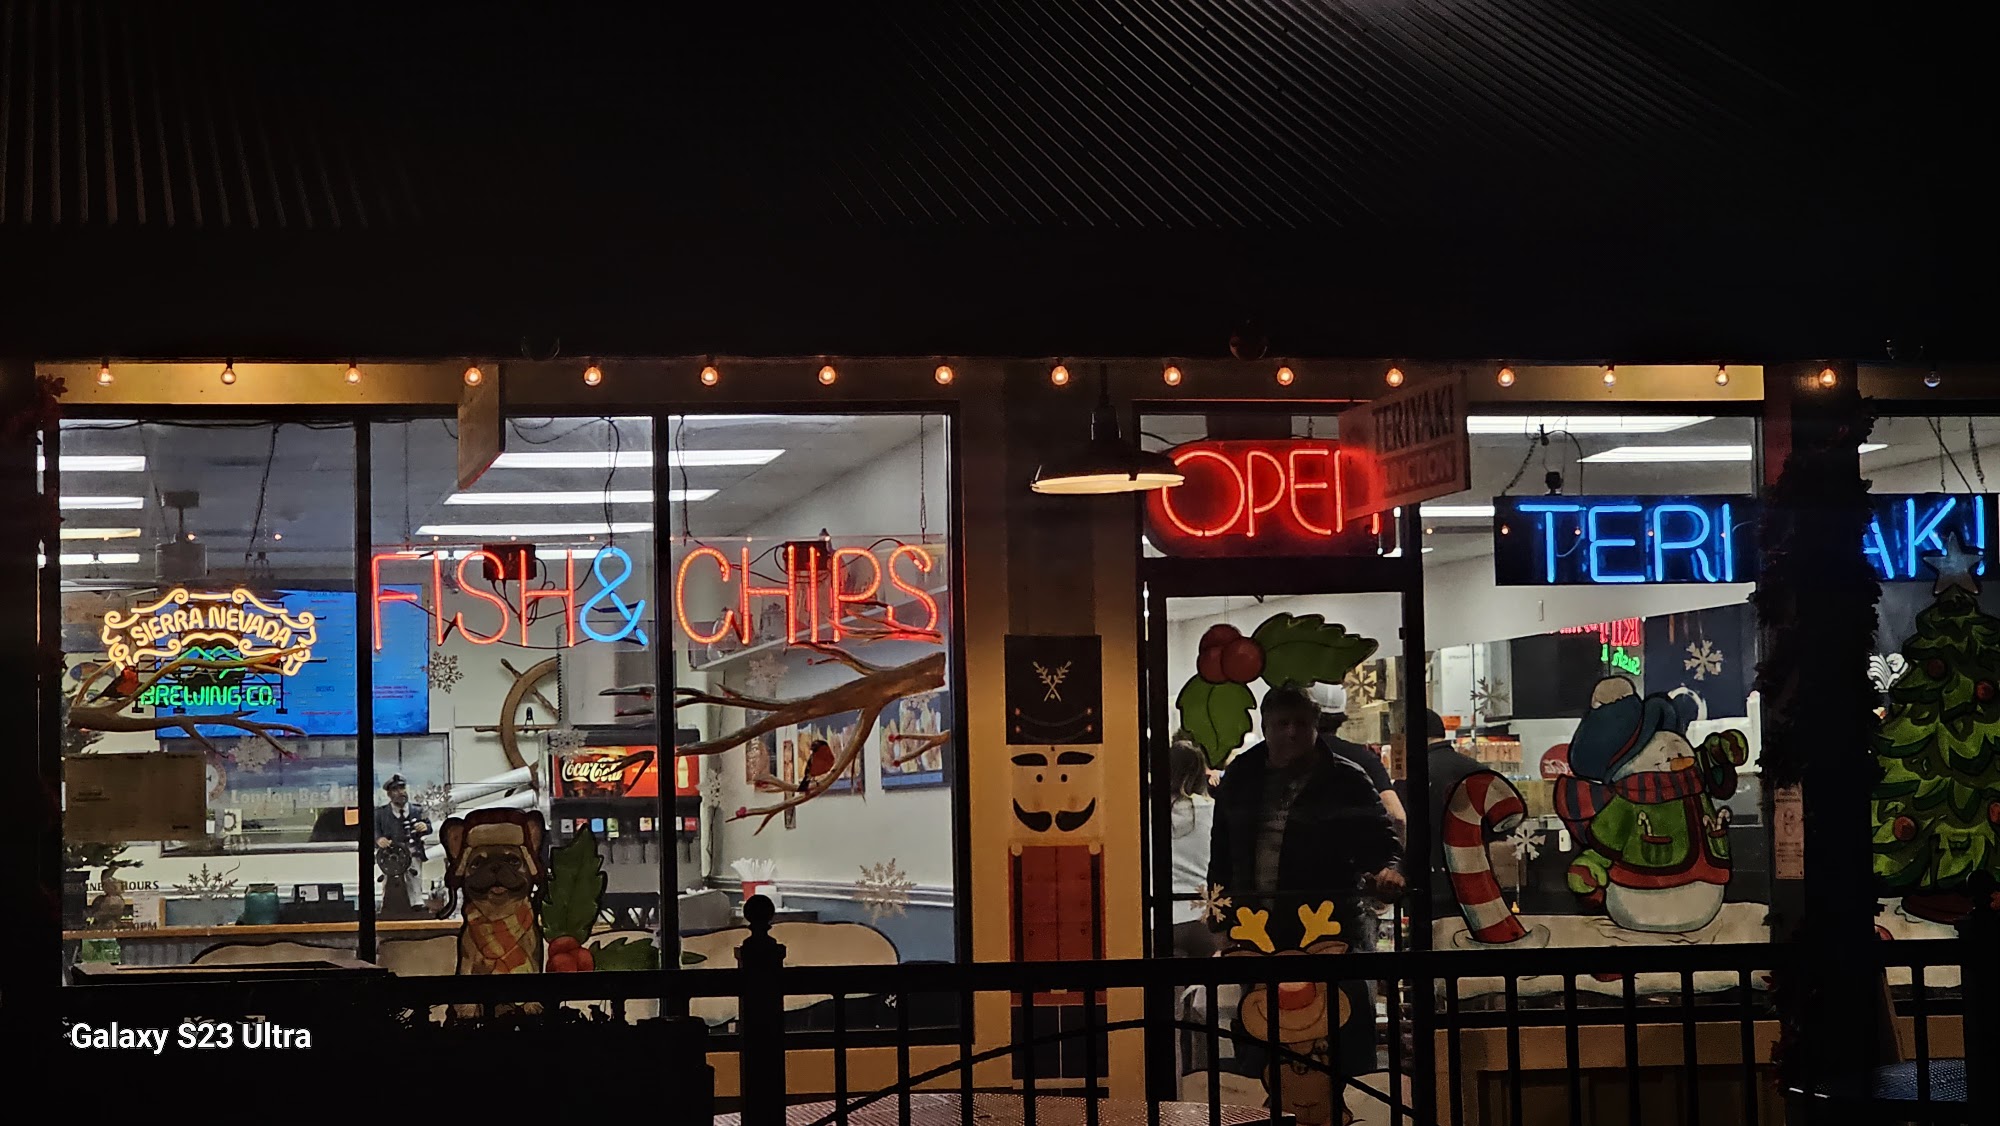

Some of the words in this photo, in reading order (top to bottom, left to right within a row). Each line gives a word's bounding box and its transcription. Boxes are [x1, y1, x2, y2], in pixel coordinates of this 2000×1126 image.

[1372, 384, 1454, 456] TERIYAKI
[371, 549, 575, 649] FISH
[579, 547, 648, 646] &
[675, 544, 941, 645] CHIPS
[130, 607, 204, 647] SIERRA
[208, 606, 292, 649] NEVADA
[140, 684, 242, 706] BREWING
[246, 685, 277, 706] CO.
[231, 786, 294, 803] London
[121, 880, 159, 891] HOURS
